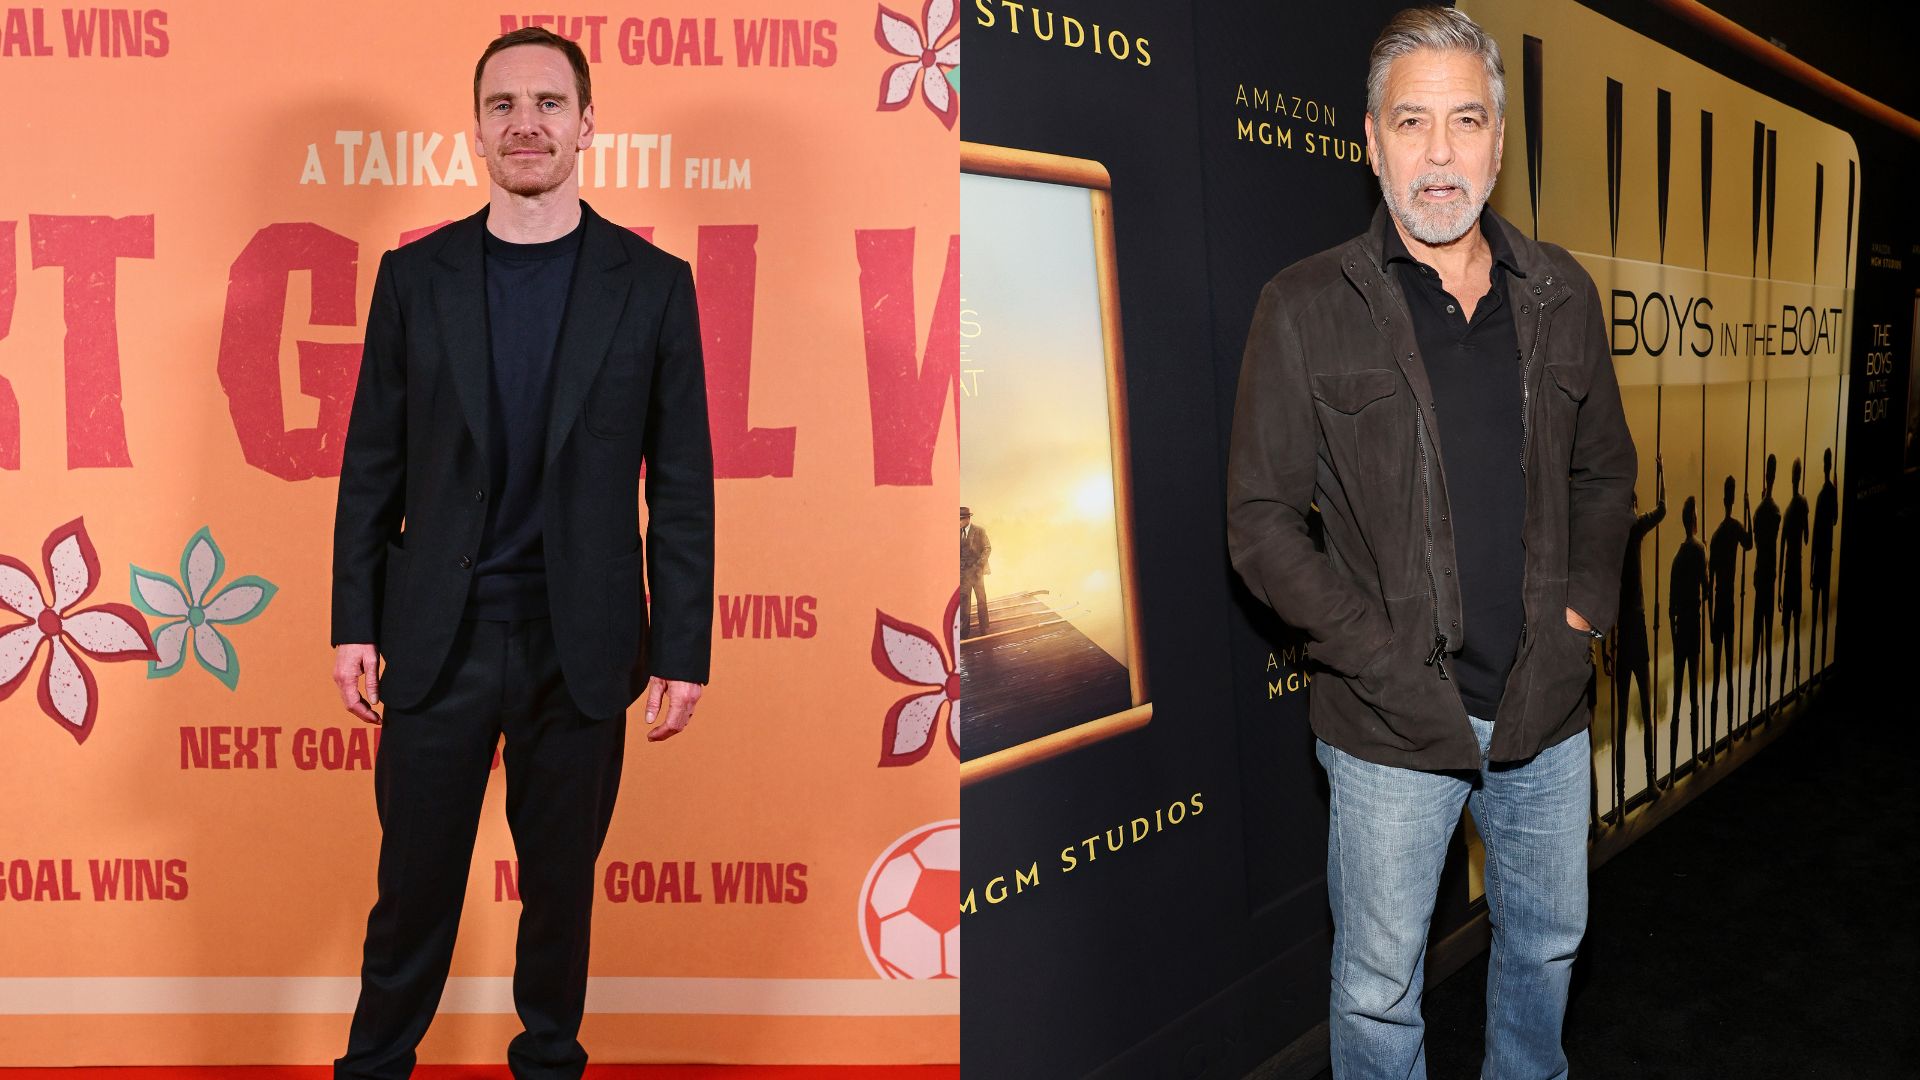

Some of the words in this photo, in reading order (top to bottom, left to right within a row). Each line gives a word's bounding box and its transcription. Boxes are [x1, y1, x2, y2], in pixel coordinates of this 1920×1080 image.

[0, 8, 53, 56] AL
[62, 8, 170, 58] WINS
[617, 17, 724, 66] GOAL
[734, 18, 837, 67] WINS
[976, 0, 1151, 66] STUDIOS
[1236, 84, 1335, 127] AMAZON
[1238, 117, 1292, 149] MGM
[300, 144, 326, 185] A
[335, 131, 478, 186] TAIKA
[684, 158, 751, 190] FILM
[1611, 289, 1714, 357] BOYS
[1720, 322, 1738, 356] IN
[1743, 323, 1777, 356] THE
[1781, 305, 1842, 356] BOAT
[1872, 324, 1892, 347] THE
[1866, 351, 1892, 376] BOYS
[1864, 397, 1889, 423] BOAT
[718, 594, 817, 640] WINS
[179, 726, 282, 770] NEXT
[1061, 793, 1205, 873] STUDIOS
[0, 859, 81, 902] OAL
[88, 858, 189, 902] WINS
[604, 860, 702, 904] GOAL
[712, 861, 809, 904] WINS
